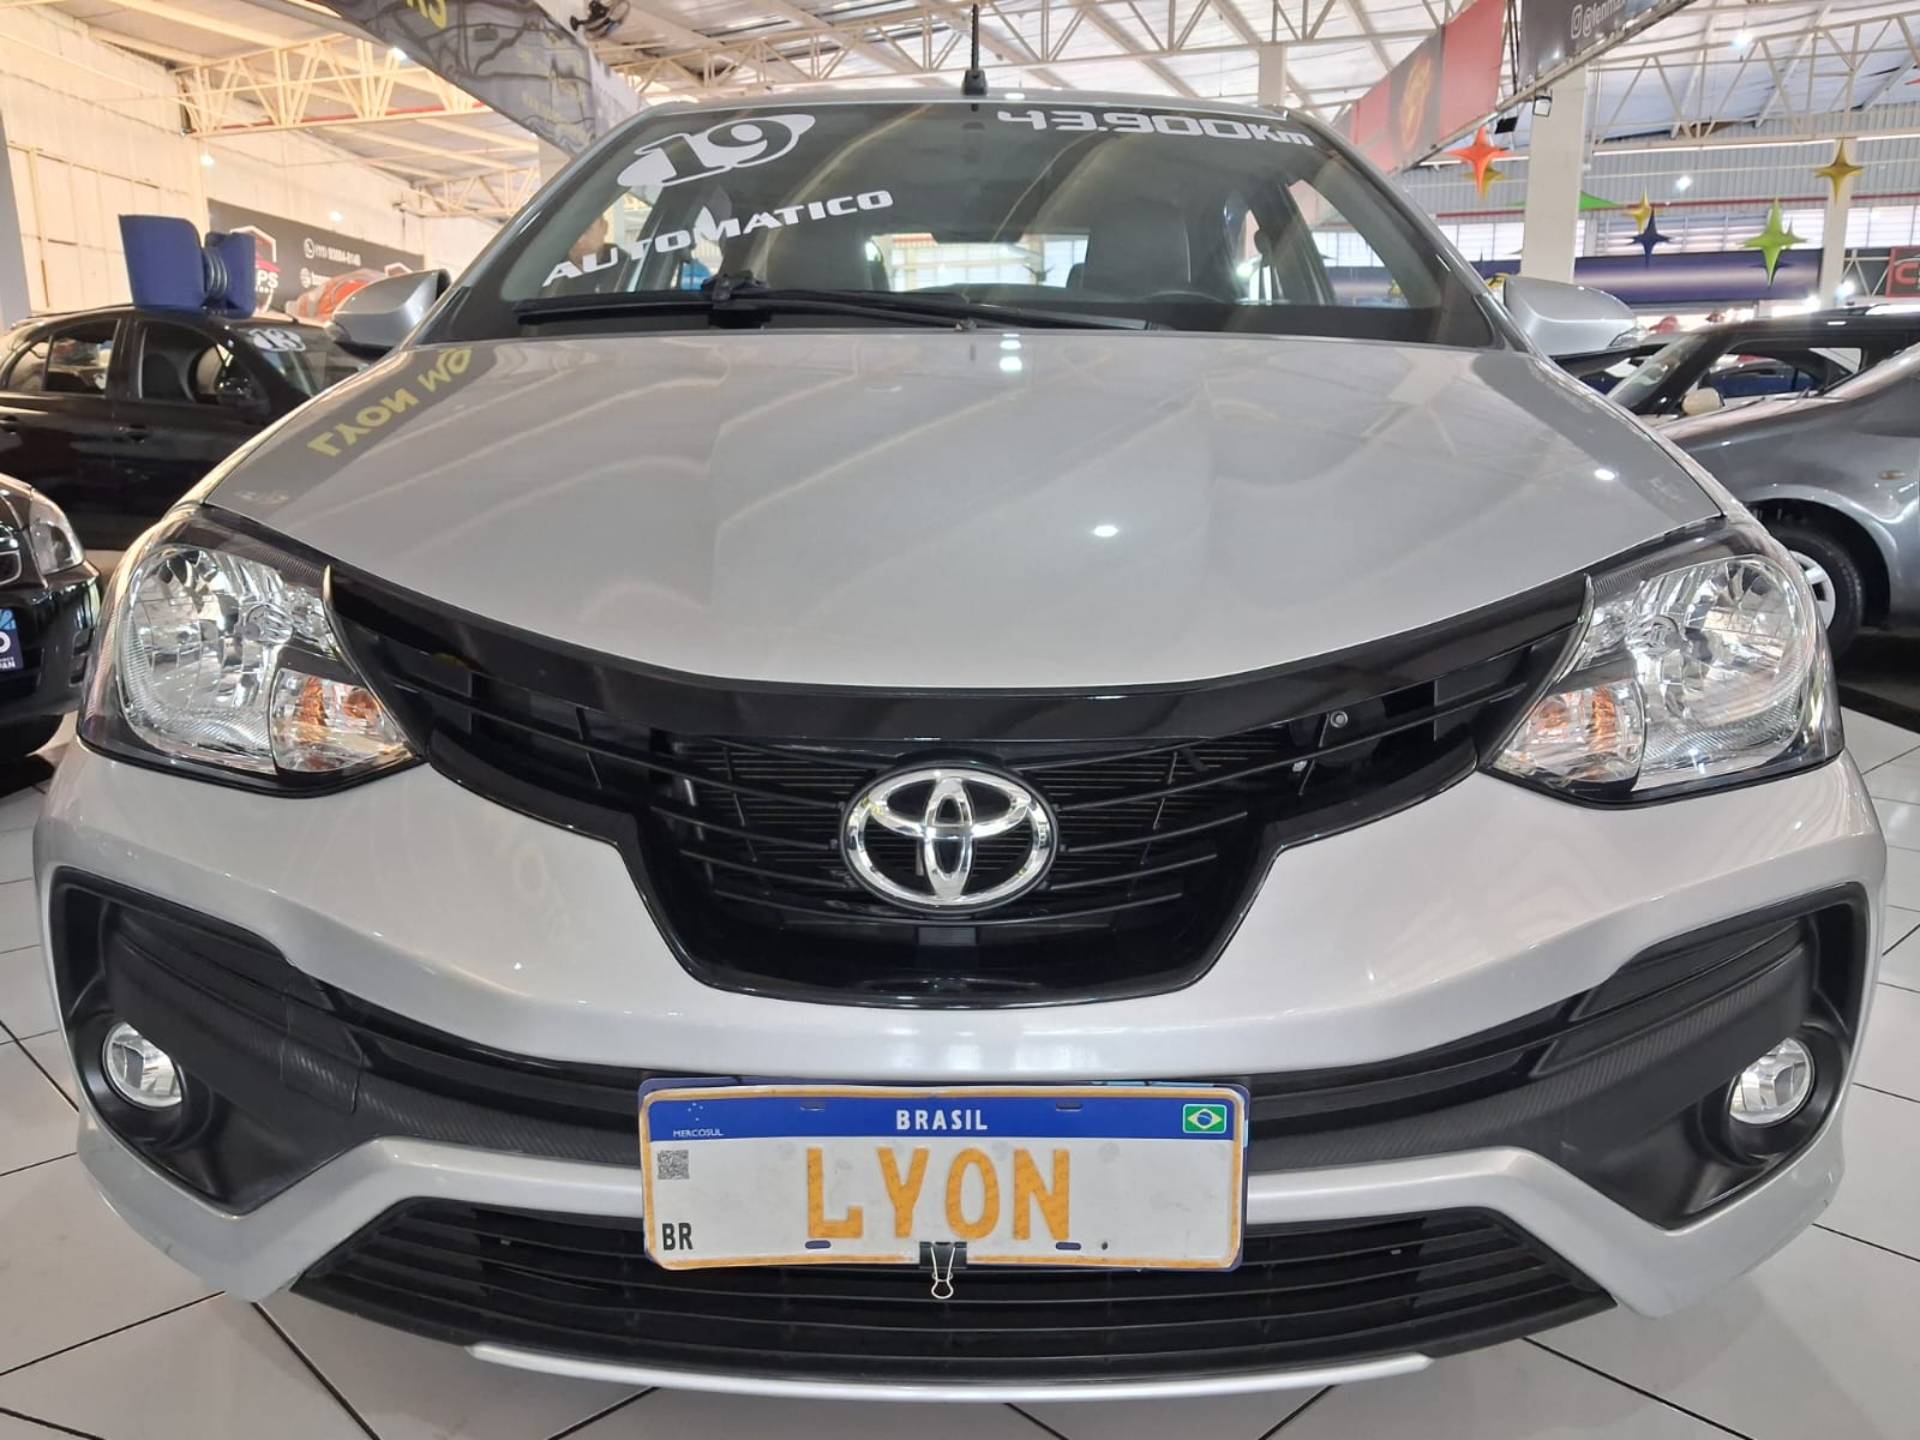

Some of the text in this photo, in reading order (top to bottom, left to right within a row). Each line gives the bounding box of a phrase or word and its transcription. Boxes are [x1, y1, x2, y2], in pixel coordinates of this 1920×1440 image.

[617, 114, 816, 187] 19
[542, 190, 894, 287] AUTOMATICO
[672, 1128, 725, 1137] MERCOSUL
[895, 1108, 988, 1131] BRASIL
[806, 1147, 1071, 1240] LYON
[662, 1222, 694, 1251] BR
